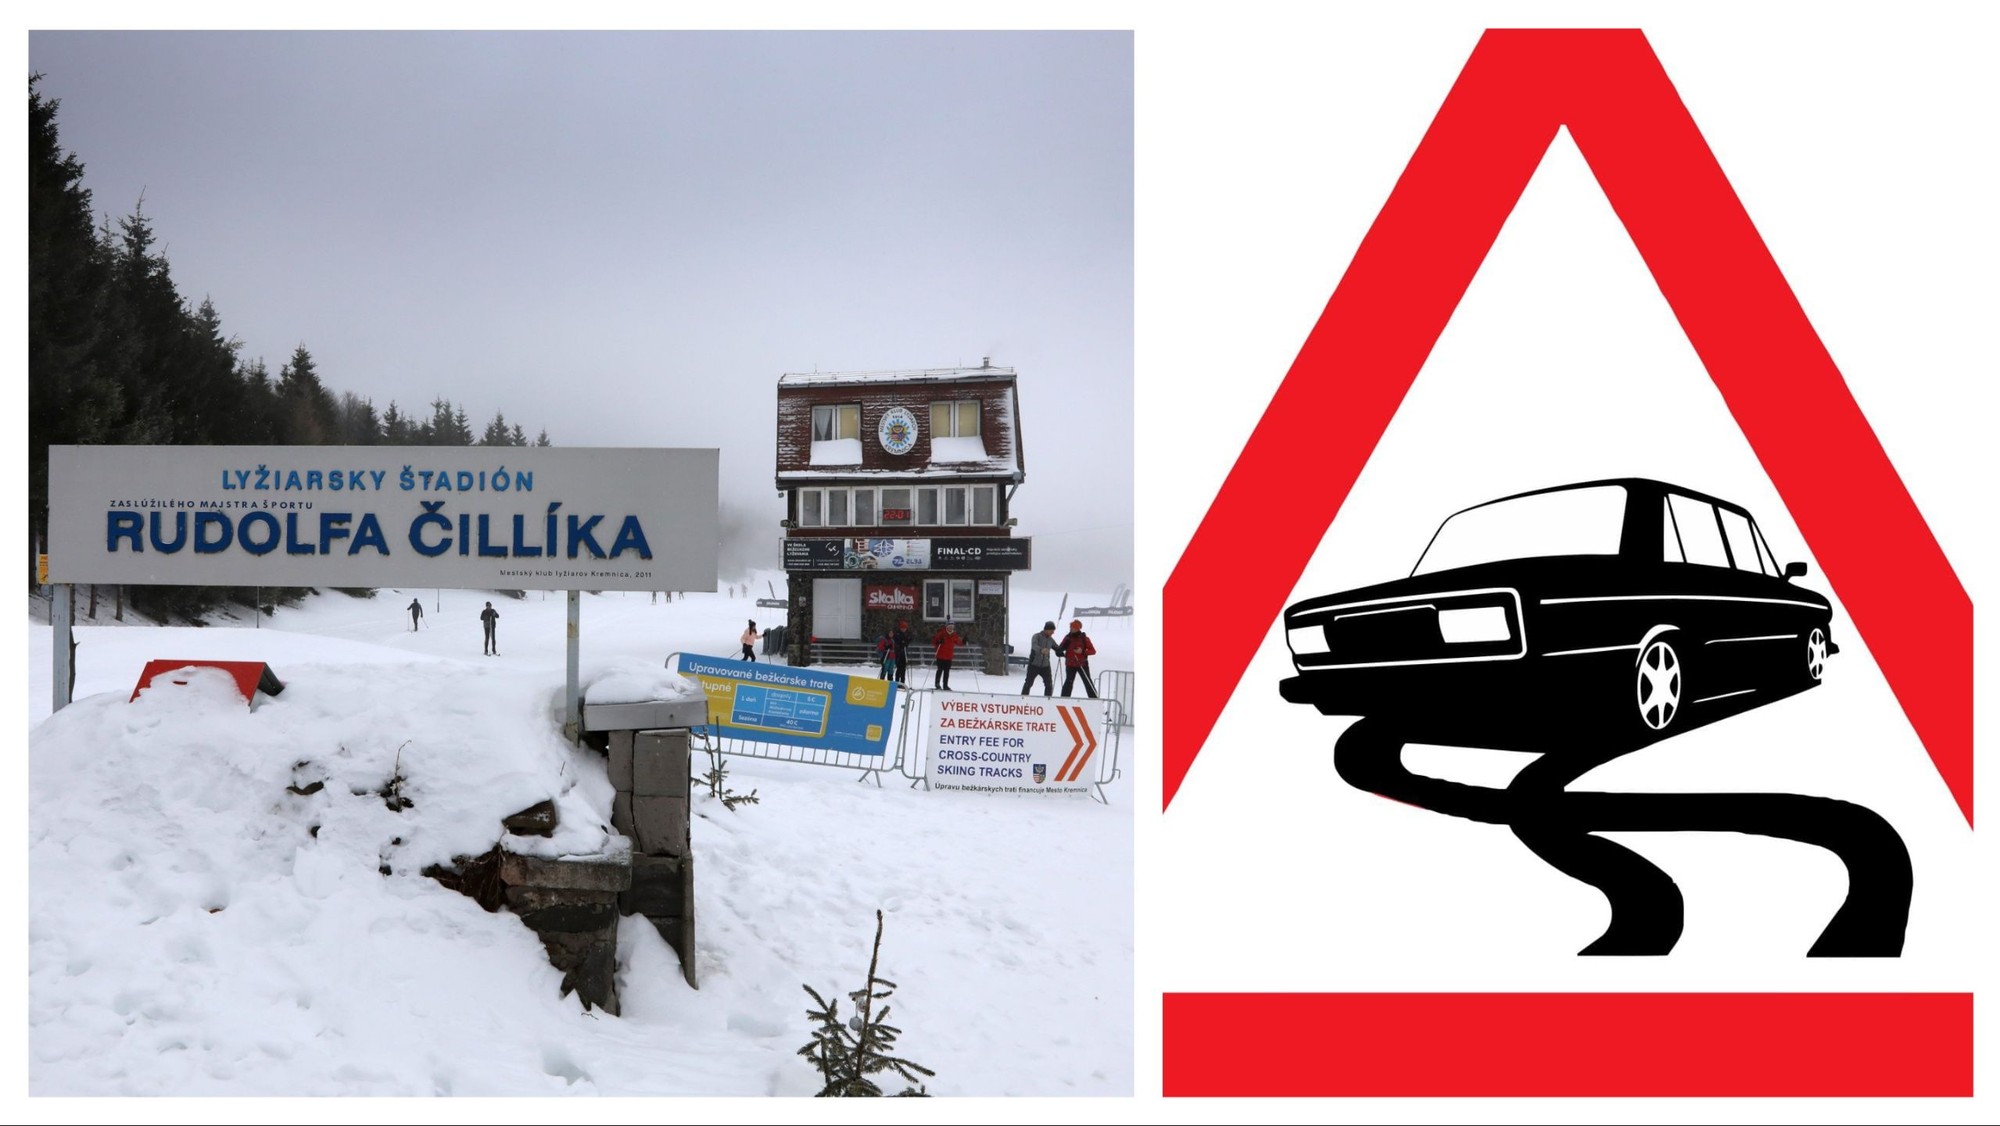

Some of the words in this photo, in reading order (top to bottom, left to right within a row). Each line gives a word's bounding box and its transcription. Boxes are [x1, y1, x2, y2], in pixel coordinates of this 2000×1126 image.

[222, 464, 387, 491] LYŽIARSKY
[399, 465, 534, 492] ŠTADIÓN
[110, 498, 195, 508] ZASLÚŽILÉHO
[200, 500, 258, 509] MAJSTRA
[263, 500, 313, 509] ŠPORTU
[107, 511, 390, 556] RUDOLFA
[408, 501, 653, 560] ČILLÍKA
[500, 569, 533, 577] Mestský
[535, 569, 553, 577] klub
[555, 570, 588, 578] lyžiarov
[590, 570, 633, 578] Kremnica,
[869, 587, 914, 604] Skalka
[689, 660, 753, 680] Upravované
[755, 669, 807, 687] bežkárske
[810, 678, 834, 690] trate
[701, 680, 732, 693] tupné
[942, 699, 979, 713] VÝBER
[981, 702, 1044, 716] VSTUPNÉHO
[940, 718, 955, 729] ZA
[958, 717, 1023, 732] BEŽKÁRSKE
[1025, 722, 1057, 733] TRATE
[939, 735, 977, 746] ENTRY
[979, 736, 1000, 747] FEE
[1002, 738, 1025, 748] FOR
[938, 750, 1032, 763] CROSS-COUNTRY
[937, 765, 976, 777] SKIING
[979, 767, 1023, 778] TRACKS
[934, 781, 961, 792] Úpravu
[961, 783, 1003, 794] bežkárskych
[1018, 786, 1045, 794] financuje
